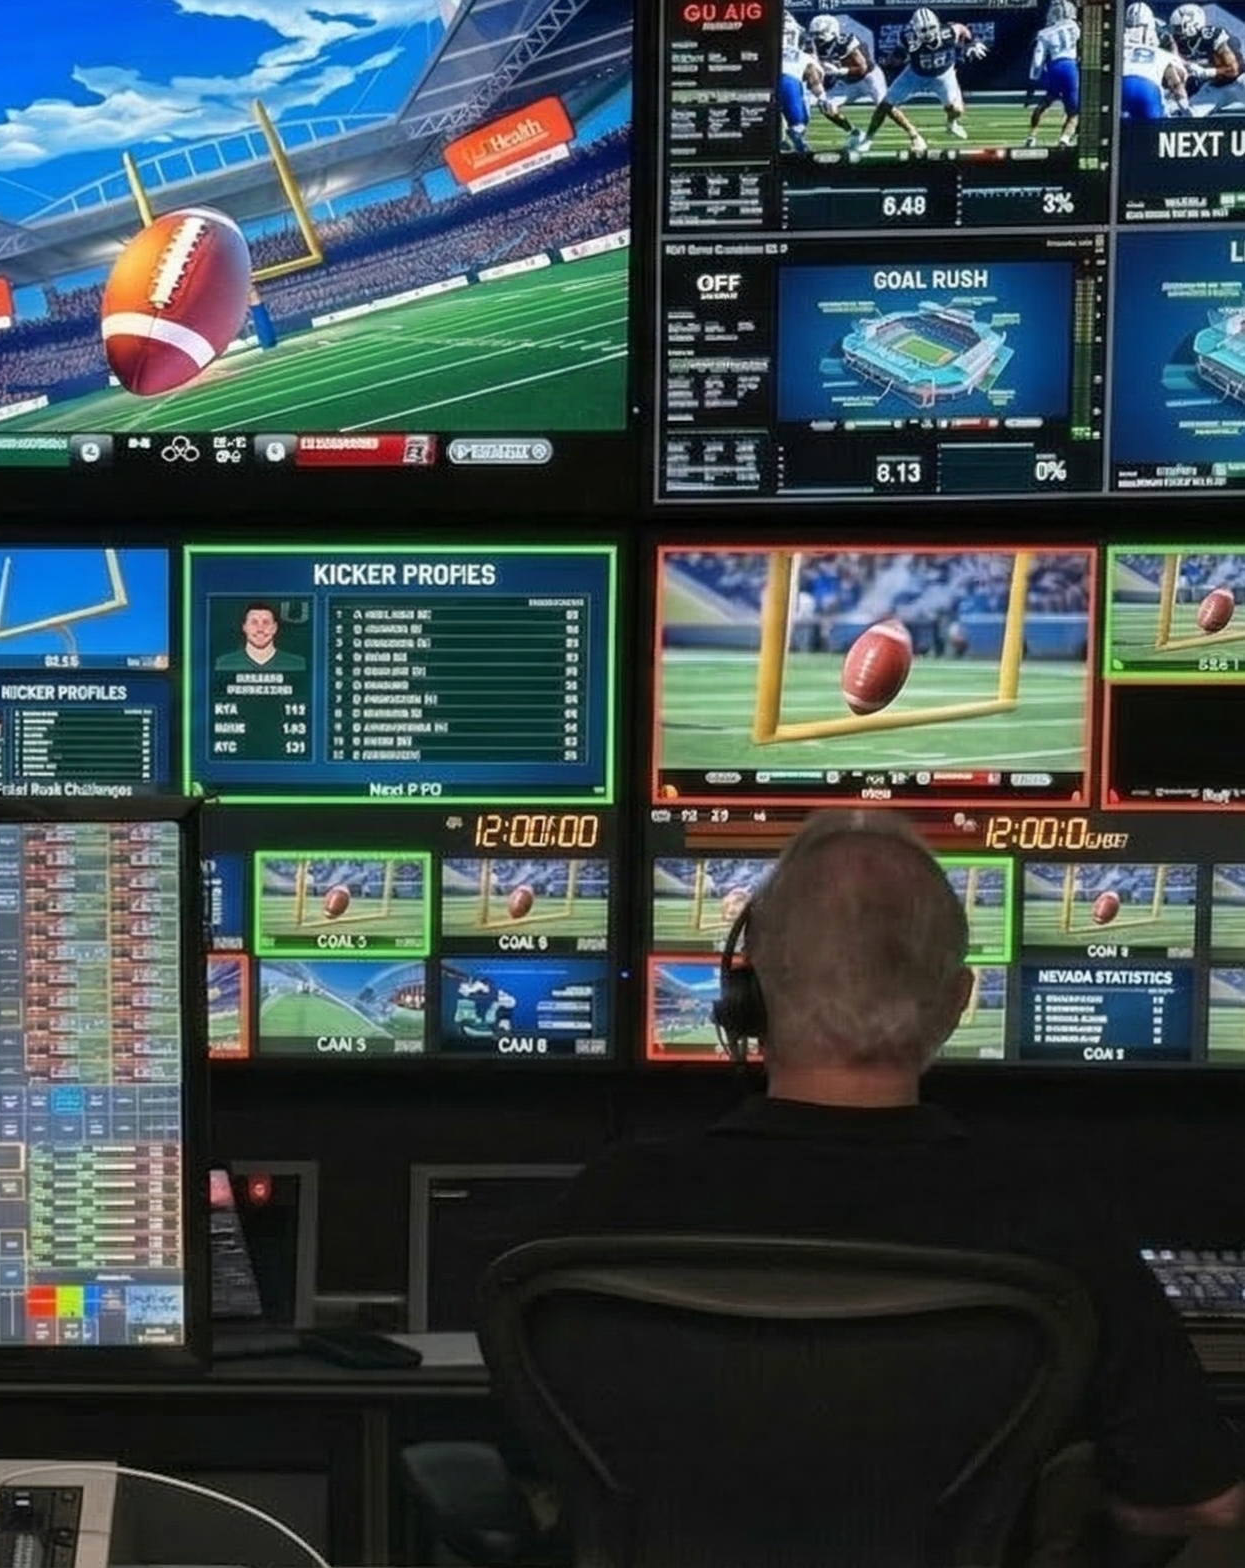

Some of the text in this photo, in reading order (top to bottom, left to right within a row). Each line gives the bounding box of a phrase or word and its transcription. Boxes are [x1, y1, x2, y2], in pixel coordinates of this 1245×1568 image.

[1159, 131, 1224, 158] NEXT
[882, 196, 926, 216] 6.48
[1043, 192, 1074, 213] 3%
[696, 274, 742, 291] OFF
[874, 270, 988, 289] GOAL RUSH
[1035, 461, 1067, 481] 0%
[314, 564, 396, 585] KICKER
[58, 685, 127, 700] PROFILES
[1039, 970, 1173, 985] NEVADA STATISTICS
